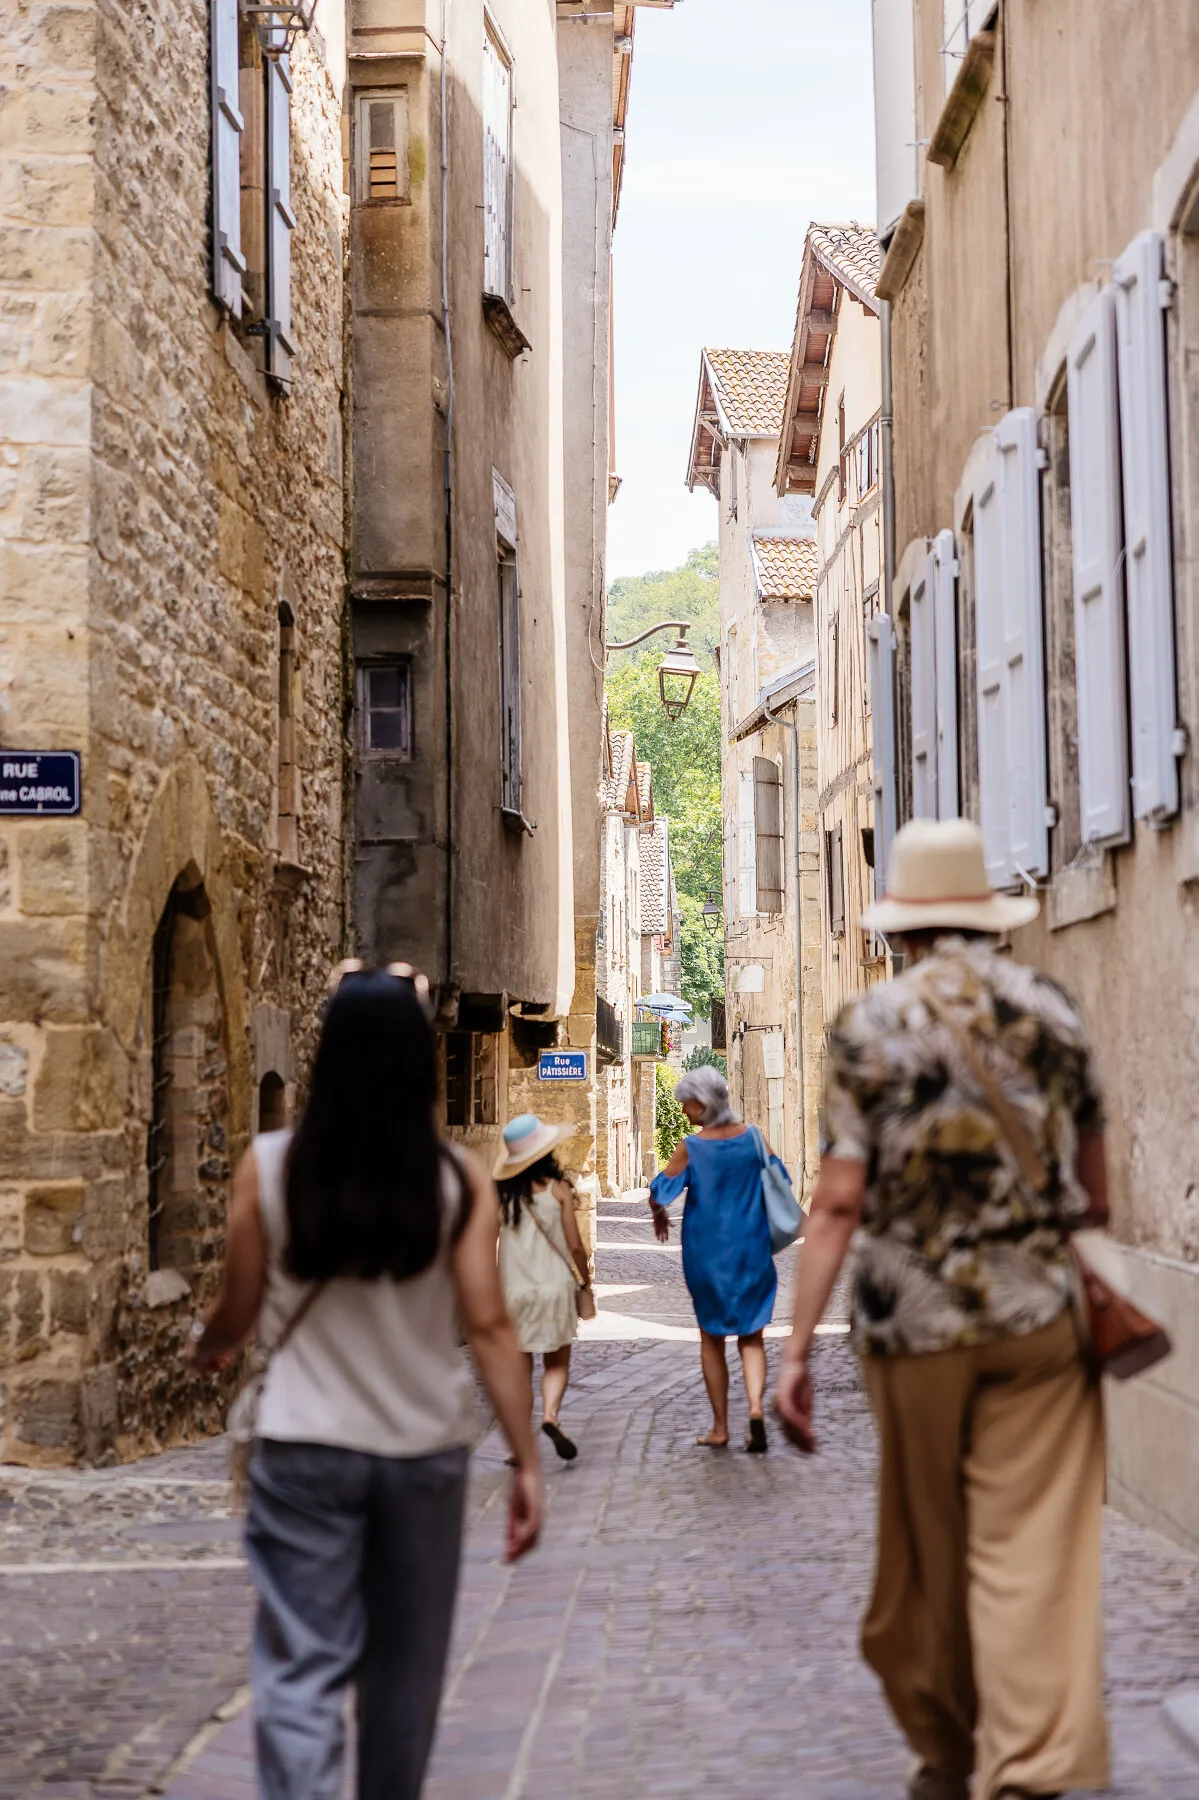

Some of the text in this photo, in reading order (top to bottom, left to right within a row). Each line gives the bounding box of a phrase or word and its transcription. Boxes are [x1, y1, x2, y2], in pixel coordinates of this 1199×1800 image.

[3, 762, 39, 778] RUE
[19, 786, 72, 802] CABROL
[554, 1056, 571, 1066] Rue
[542, 1065, 583, 1076] PÂTISSIÈRE
